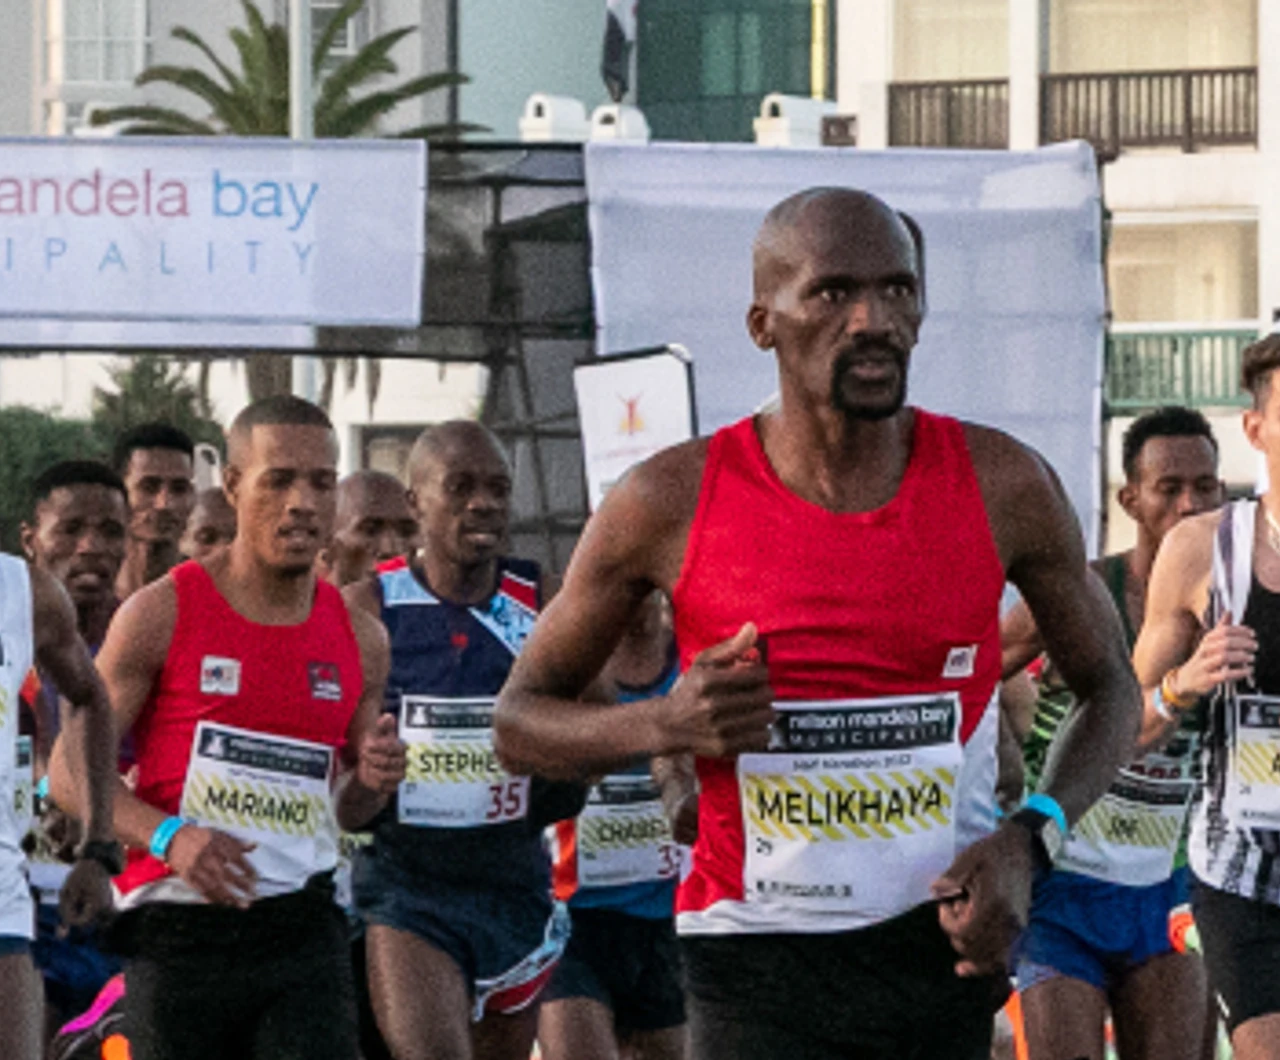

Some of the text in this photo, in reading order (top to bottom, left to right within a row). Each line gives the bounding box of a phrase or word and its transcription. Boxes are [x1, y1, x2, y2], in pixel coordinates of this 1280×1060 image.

[211, 167, 320, 233] bay
[788, 705, 951, 731] nelson mandela bay
[204, 785, 310, 825] MARIANO
[486, 782, 522, 819] 35
[757, 781, 942, 826] MELIKHAYA
